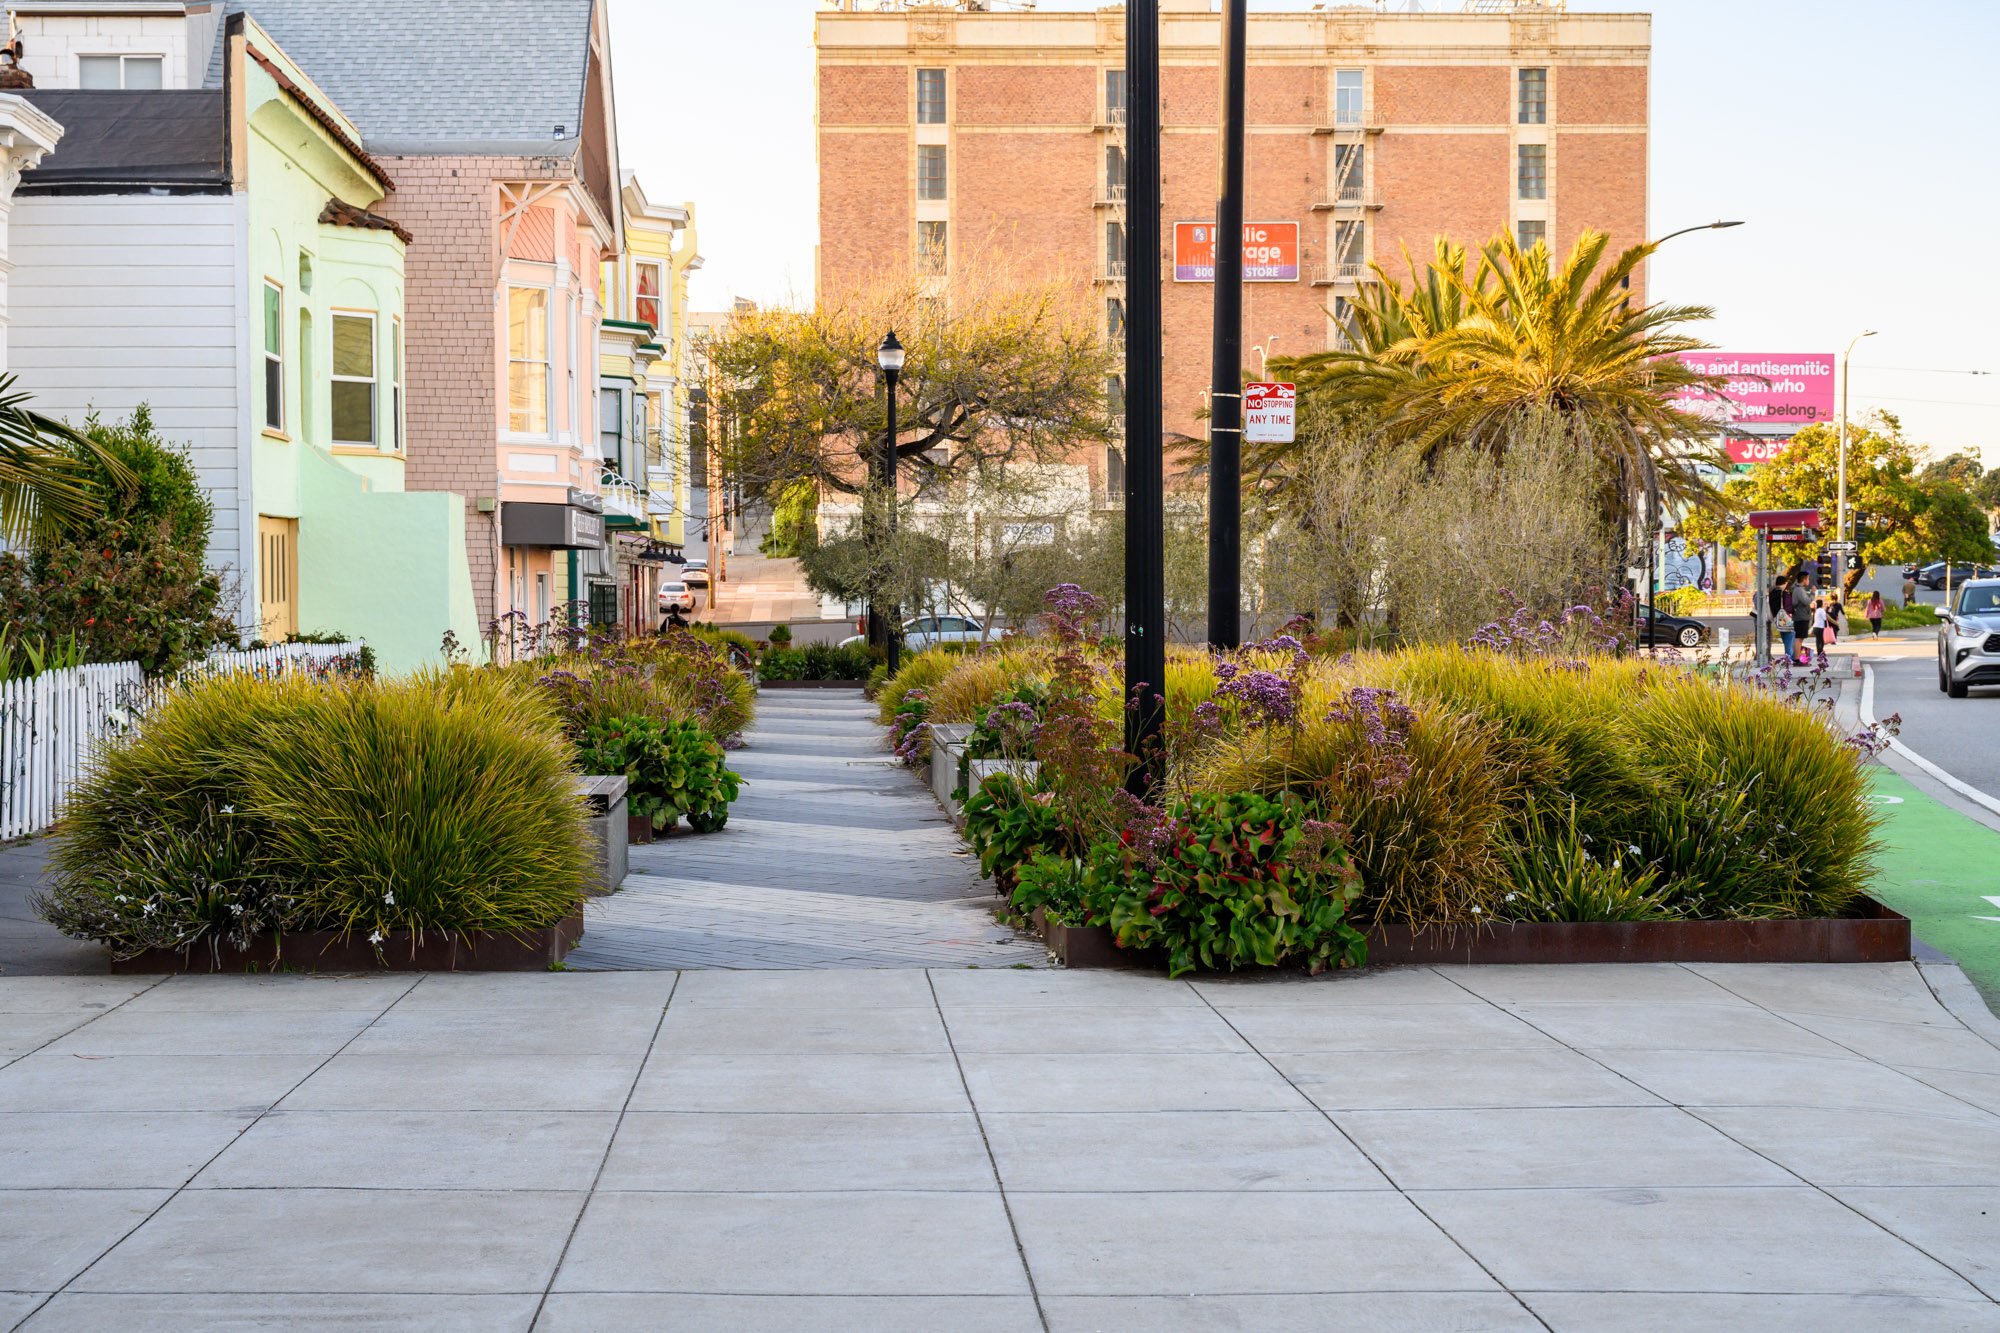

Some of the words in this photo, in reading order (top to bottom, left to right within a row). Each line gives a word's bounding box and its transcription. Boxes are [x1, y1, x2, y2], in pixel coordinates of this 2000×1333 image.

[1211, 227, 1268, 242] lic
[1210, 243, 1281, 263] Sage
[1708, 360, 1739, 375] and
[1741, 361, 1830, 376] antisemitic
[1771, 379, 1805, 393] who
[1247, 400, 1261, 408] NO
[1263, 400, 1293, 408] STOPPING
[1249, 415, 1267, 424] ANY
[1271, 415, 1291, 424] TIME
